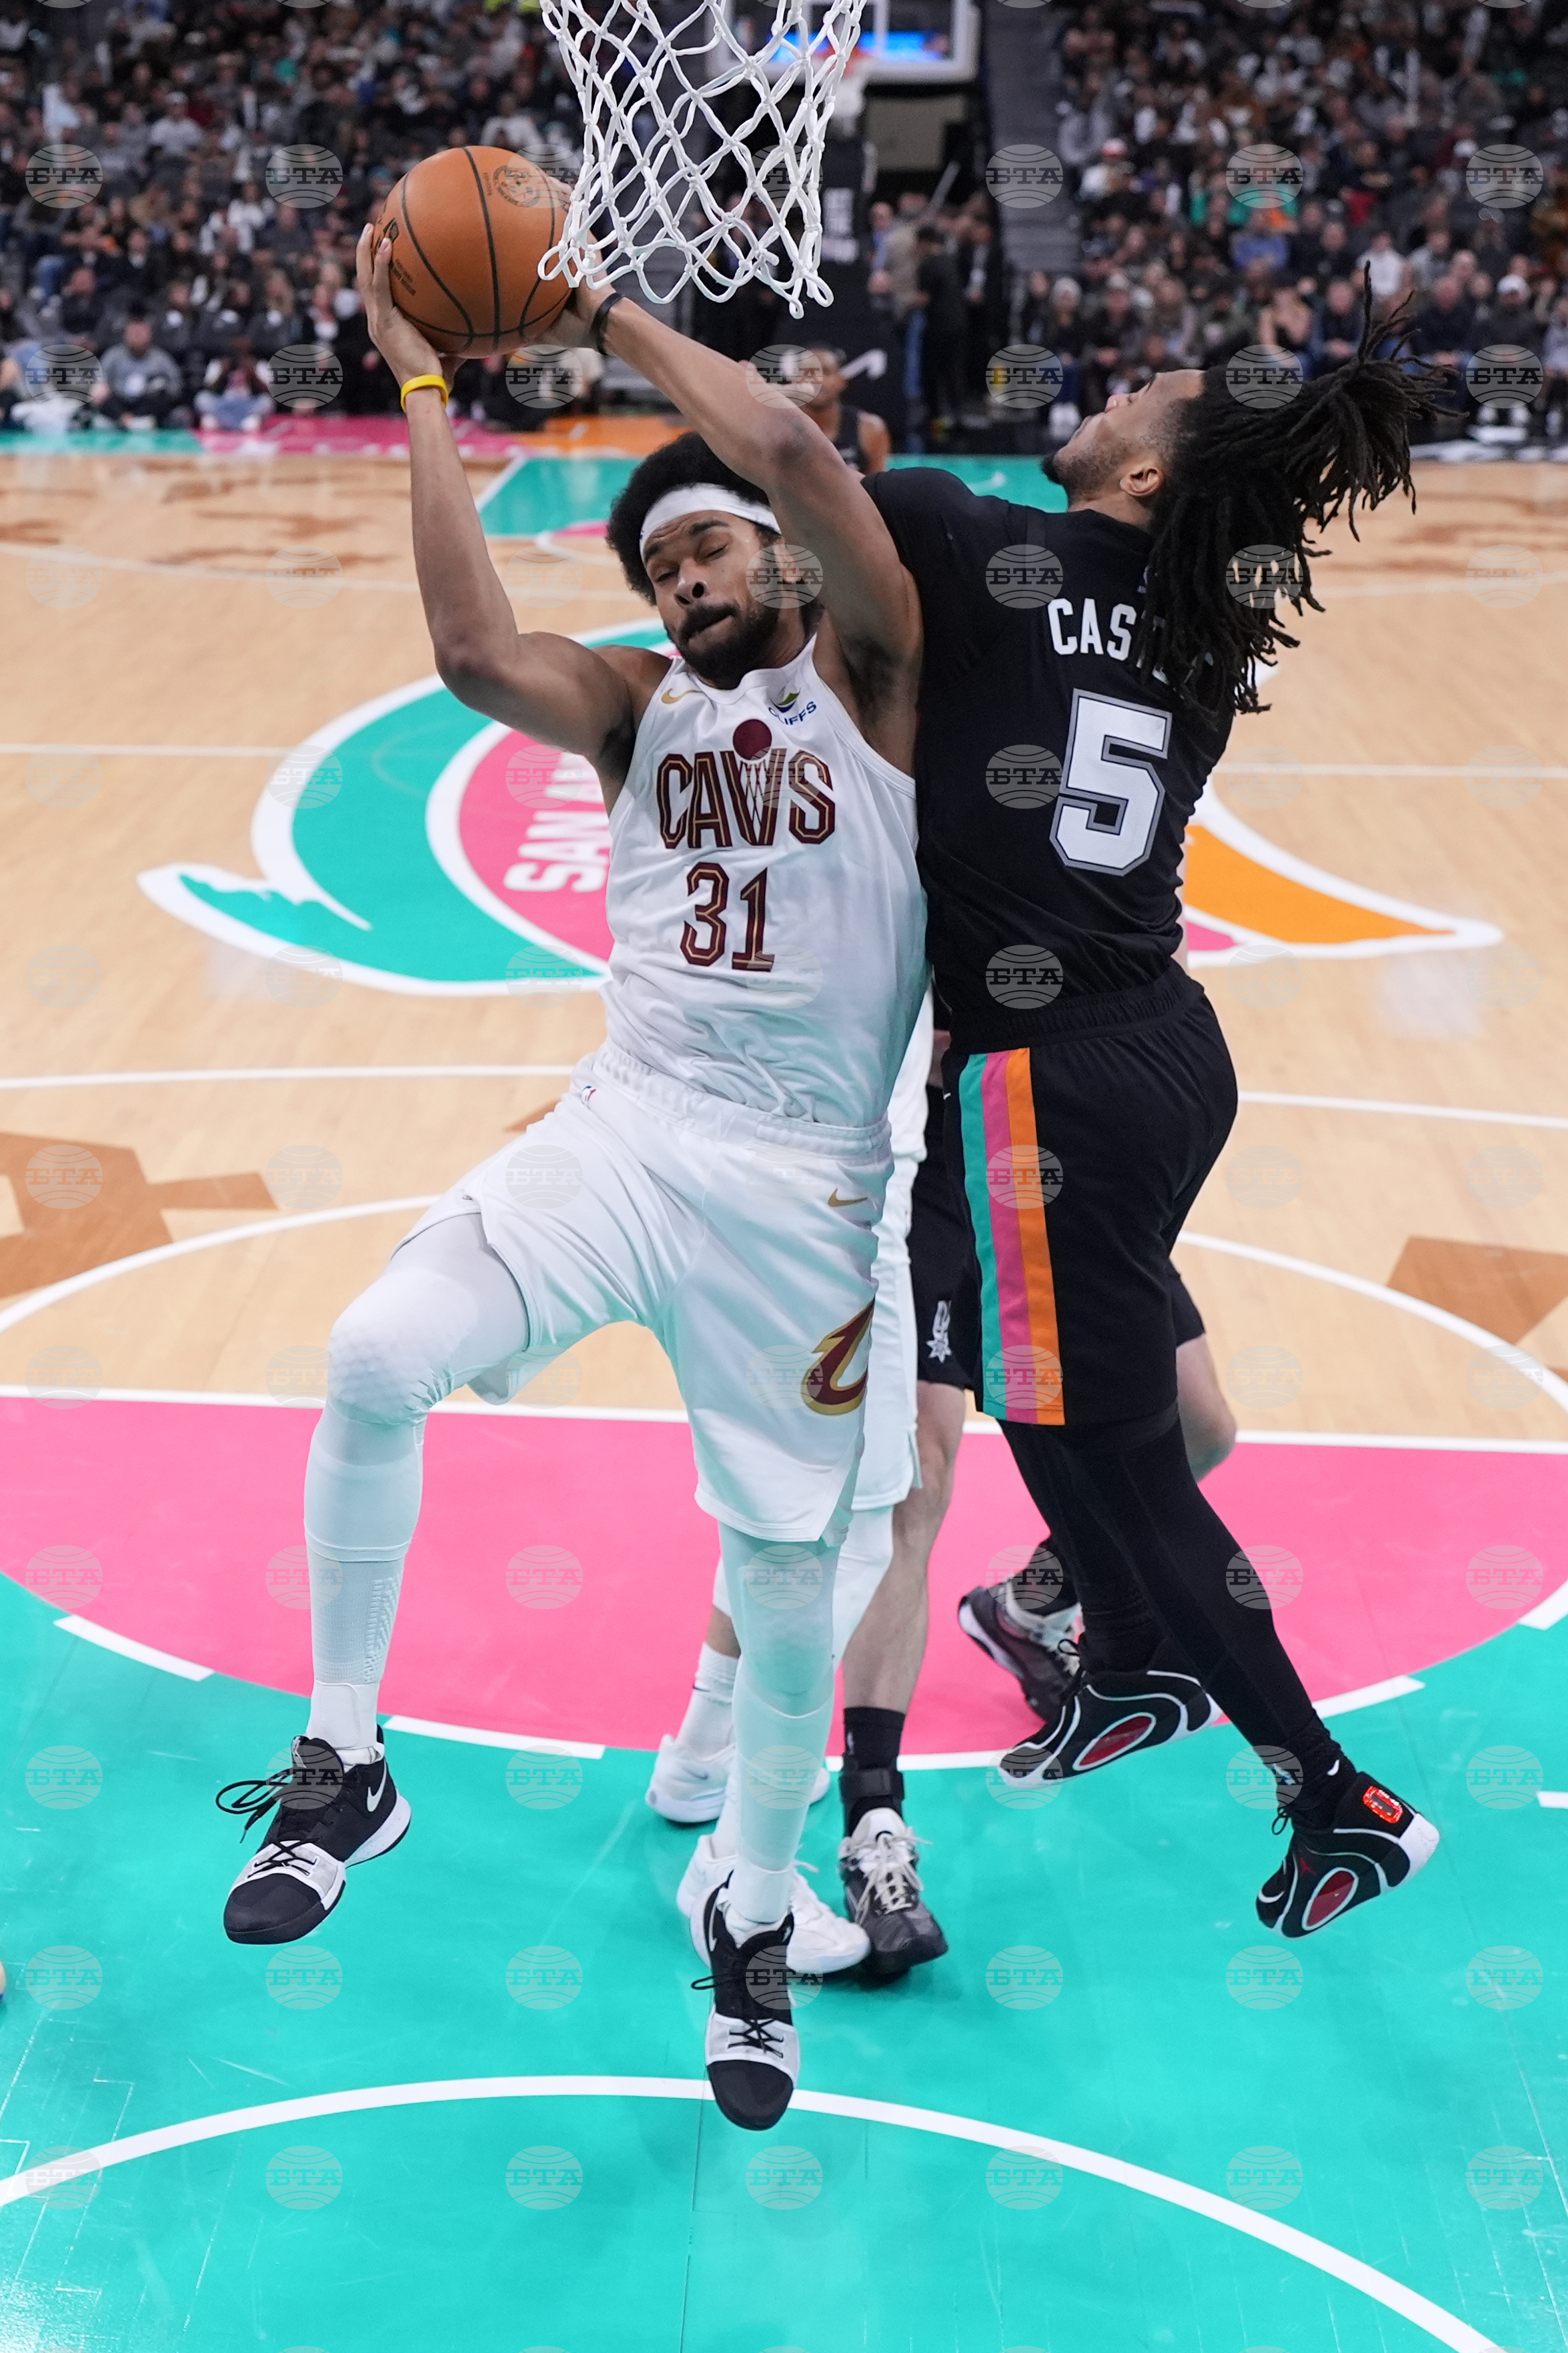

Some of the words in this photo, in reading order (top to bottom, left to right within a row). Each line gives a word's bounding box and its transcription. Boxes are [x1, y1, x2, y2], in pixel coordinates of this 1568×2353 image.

[657, 747, 835, 849] CAVS
[1049, 688, 1172, 877] 5
[504, 811, 612, 893] SAN
[680, 862, 775, 972] 31
